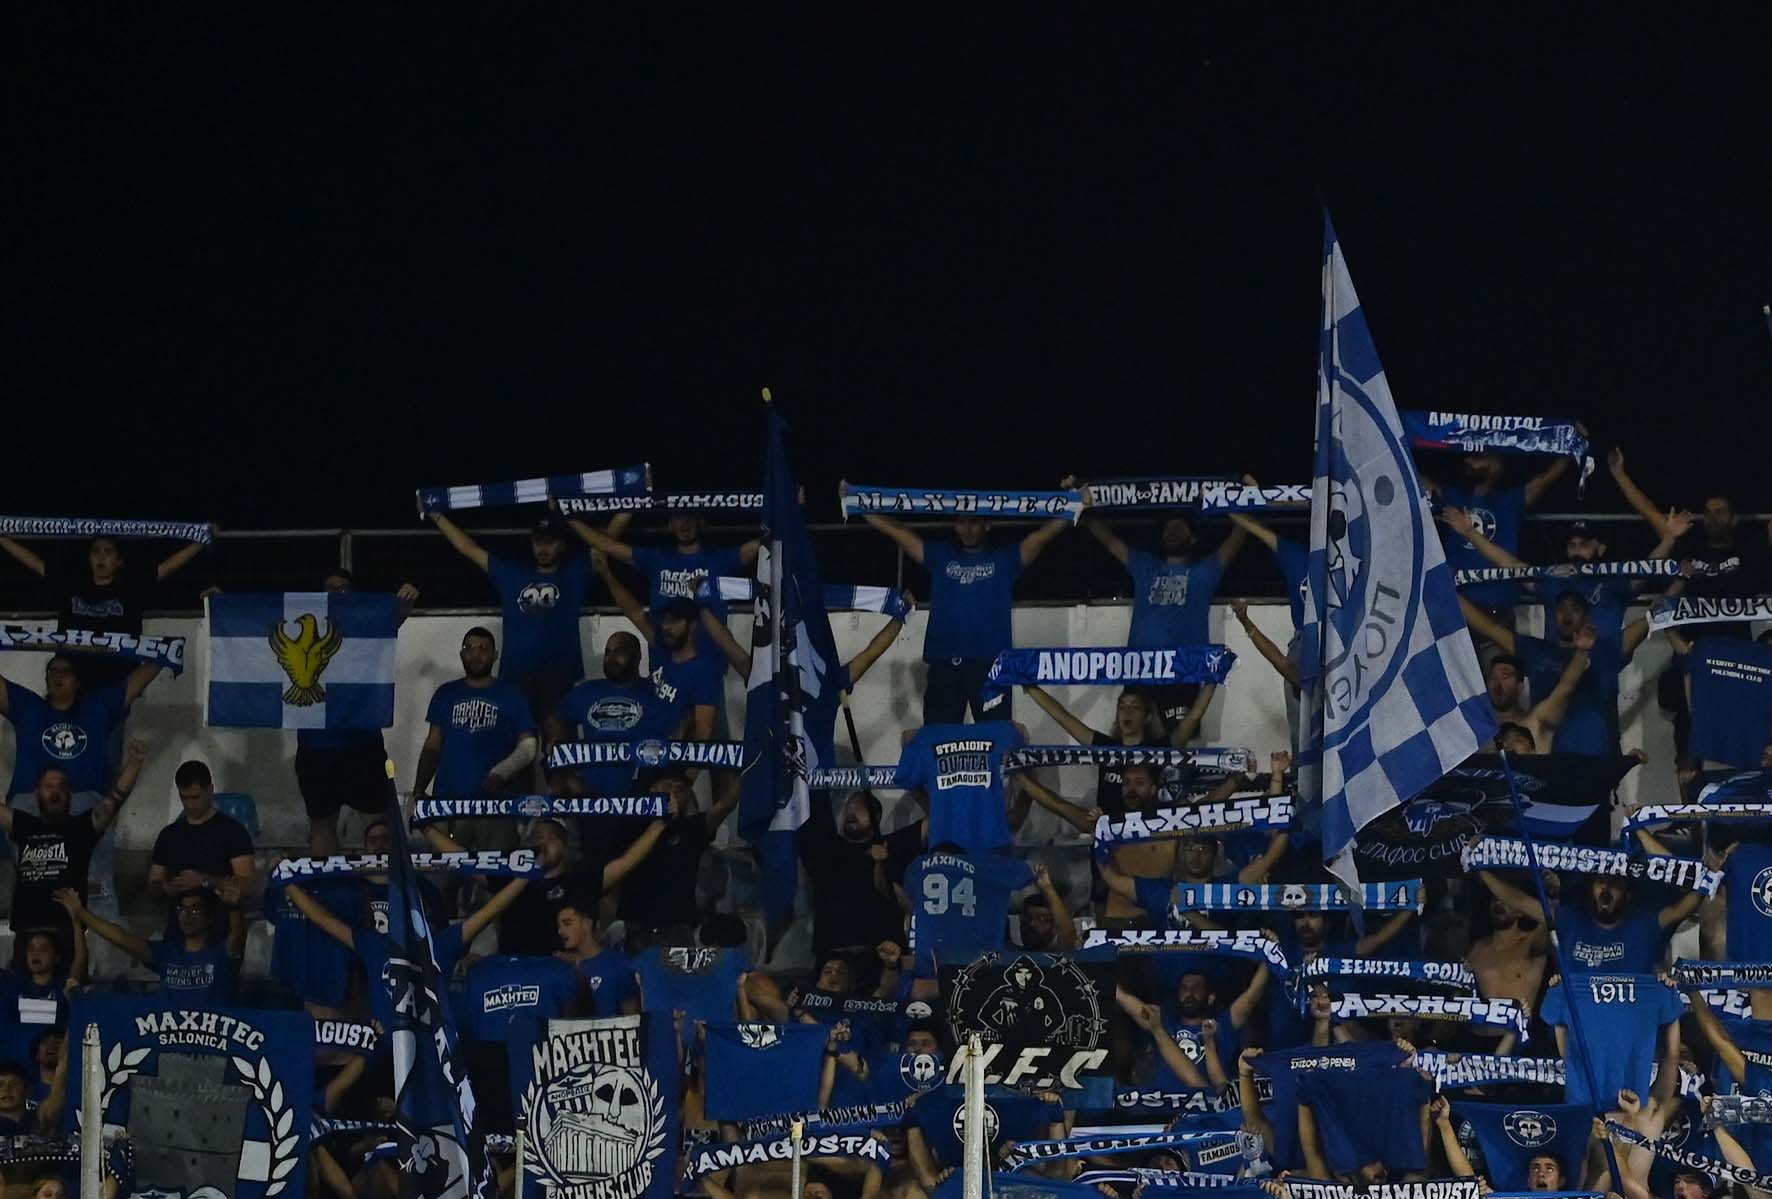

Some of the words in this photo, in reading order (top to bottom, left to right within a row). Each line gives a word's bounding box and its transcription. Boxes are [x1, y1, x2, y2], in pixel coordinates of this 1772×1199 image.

[557, 496, 654, 517] FREEDOM
[1455, 566, 1542, 586] AXHTEC
[1580, 558, 1682, 577] SALONIC
[1036, 650, 1177, 680] ΑΝΟΡΘΩΣΙΣ
[550, 742, 632, 768] AXHTEC
[936, 741, 993, 761] STRAIGHT
[551, 796, 665, 818] SALONICA
[923, 872, 987, 917] 94
[1590, 983, 1637, 1005] 1911
[135, 1010, 266, 1053] MAXHTEC
[158, 1033, 229, 1052] SALONICA
